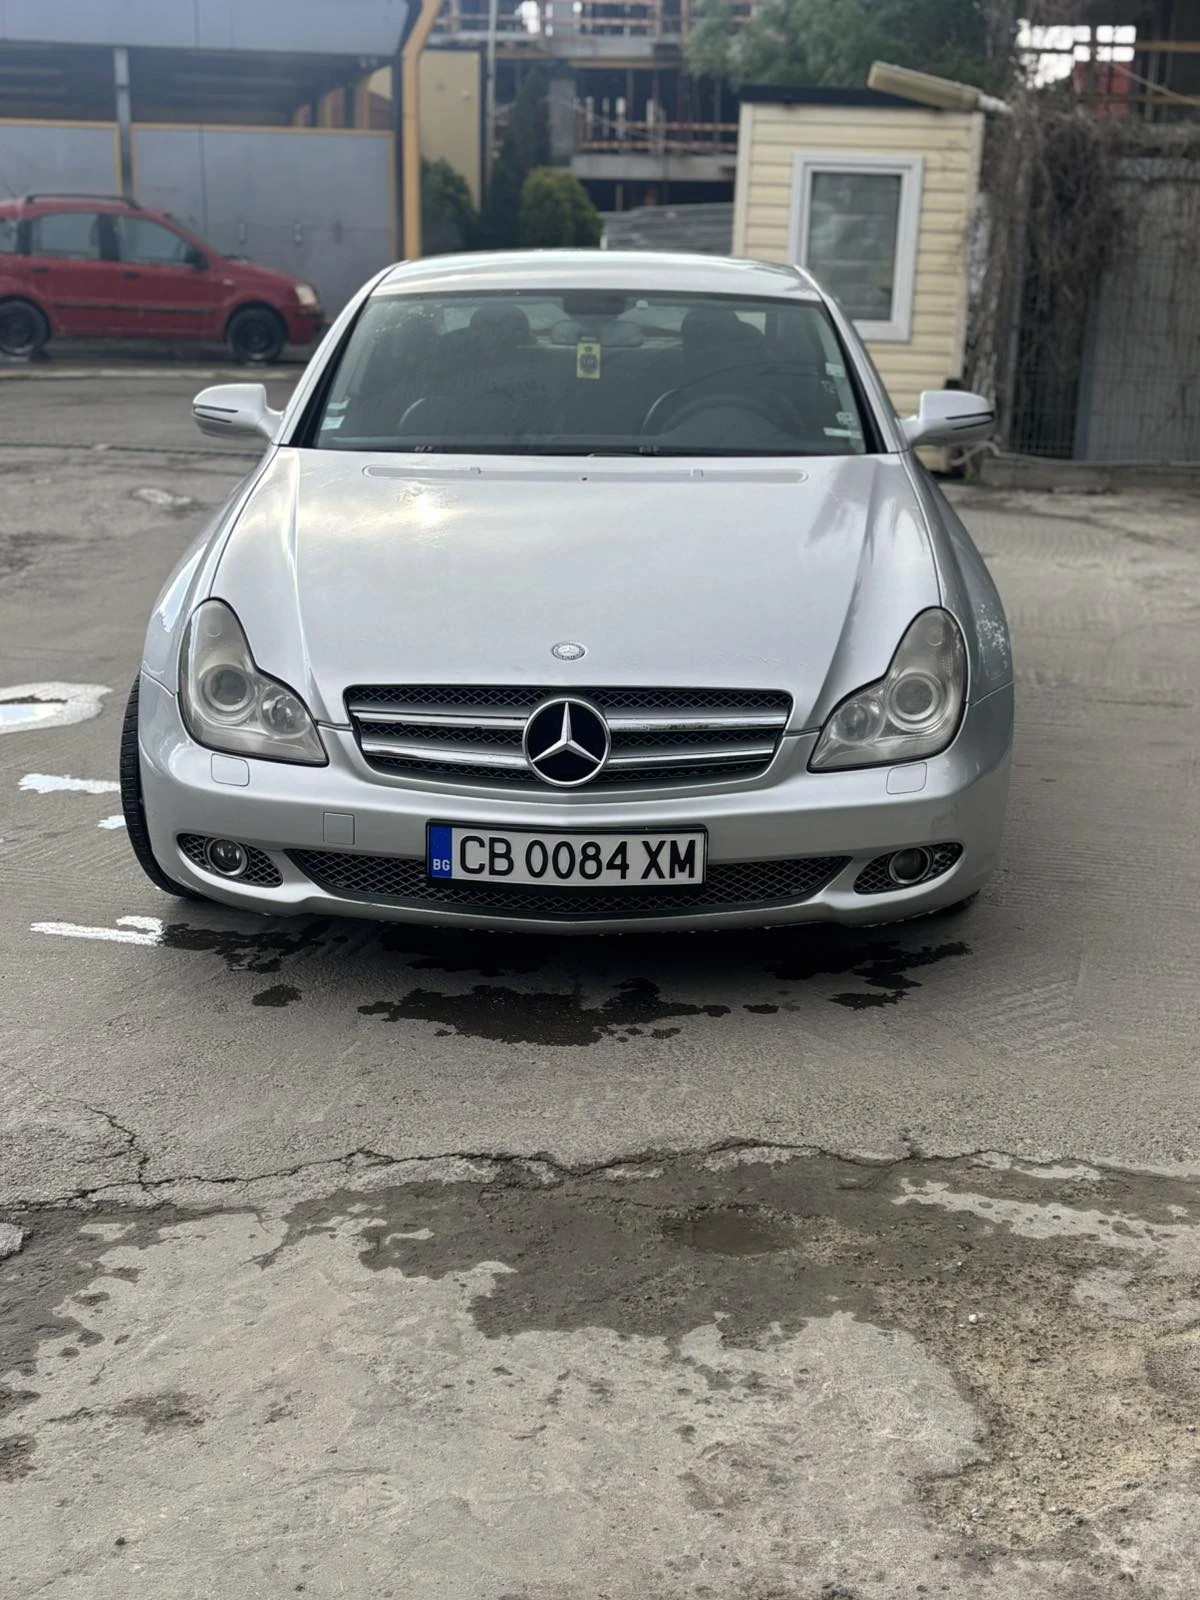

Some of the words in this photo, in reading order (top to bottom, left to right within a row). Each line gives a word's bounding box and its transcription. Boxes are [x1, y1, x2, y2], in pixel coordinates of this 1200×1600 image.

[432, 858, 450, 871] BG
[459, 836, 514, 876] CB
[525, 839, 630, 880] 0084
[641, 839, 696, 879] XM
